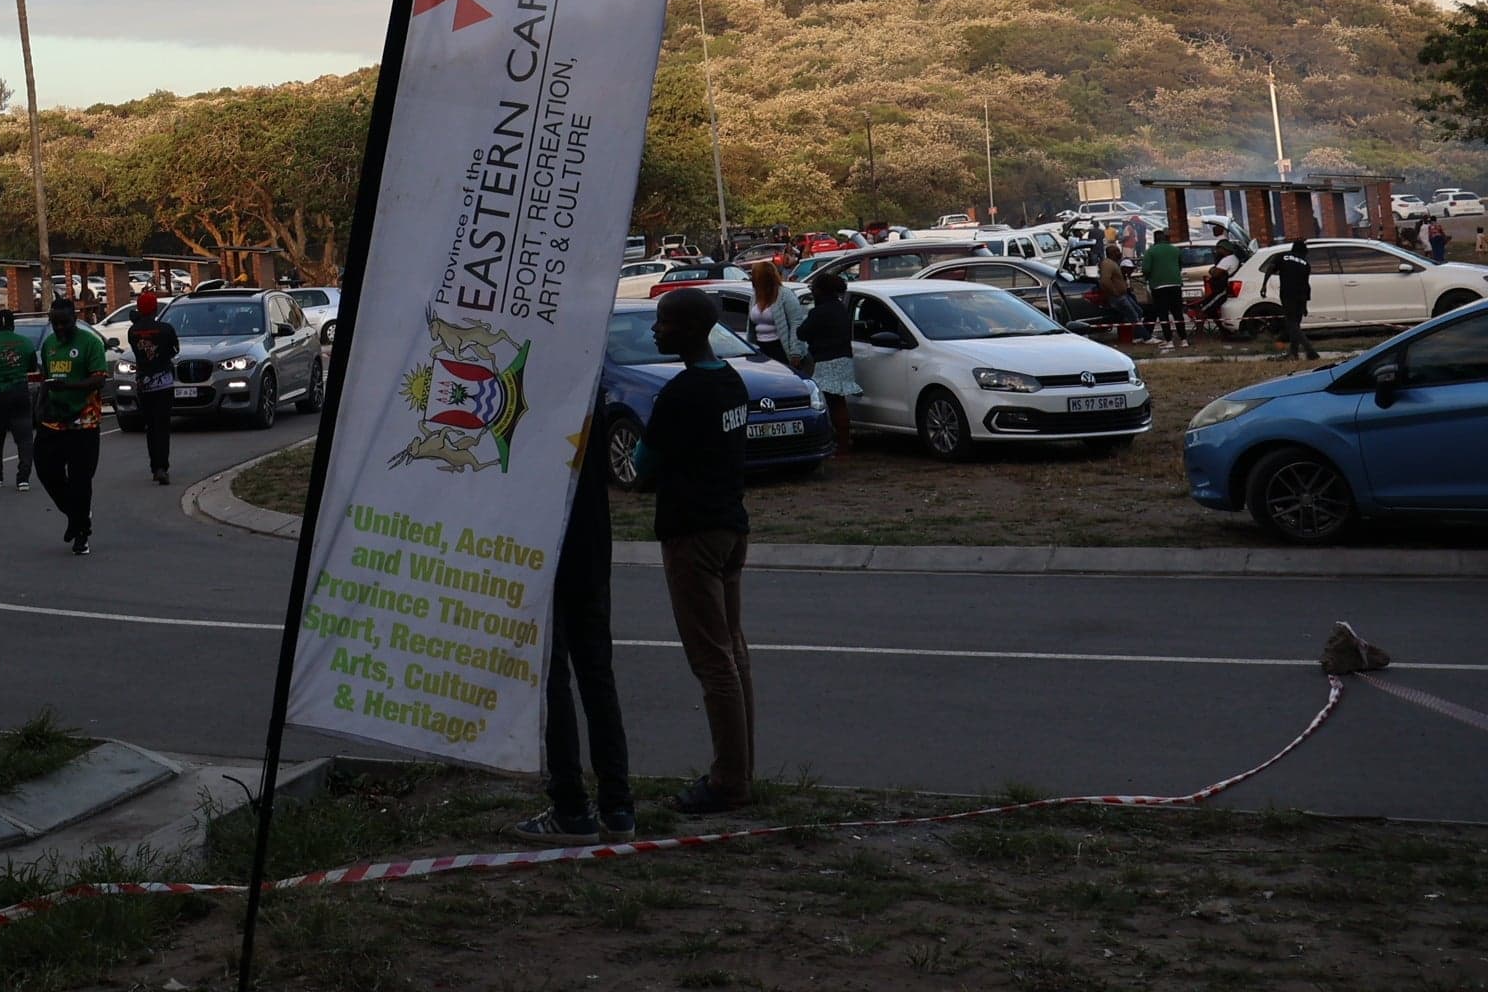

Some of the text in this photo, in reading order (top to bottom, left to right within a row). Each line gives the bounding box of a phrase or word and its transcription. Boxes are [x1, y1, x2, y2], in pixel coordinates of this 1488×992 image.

[435, 148, 484, 305] Province of the
[457, 101, 530, 312] EASTERN
[511, 58, 578, 318] SPORT, RECREATION,
[537, 113, 592, 325] ARTS & CULTURE
[722, 403, 748, 432] CREW
[351, 545, 525, 609] and Winning
[455, 527, 545, 571] Active
[303, 604, 538, 688] Sport, Recreation,
[313, 569, 538, 648] Province Through
[330, 647, 498, 711] Arts, Culture
[334, 683, 355, 712] &
